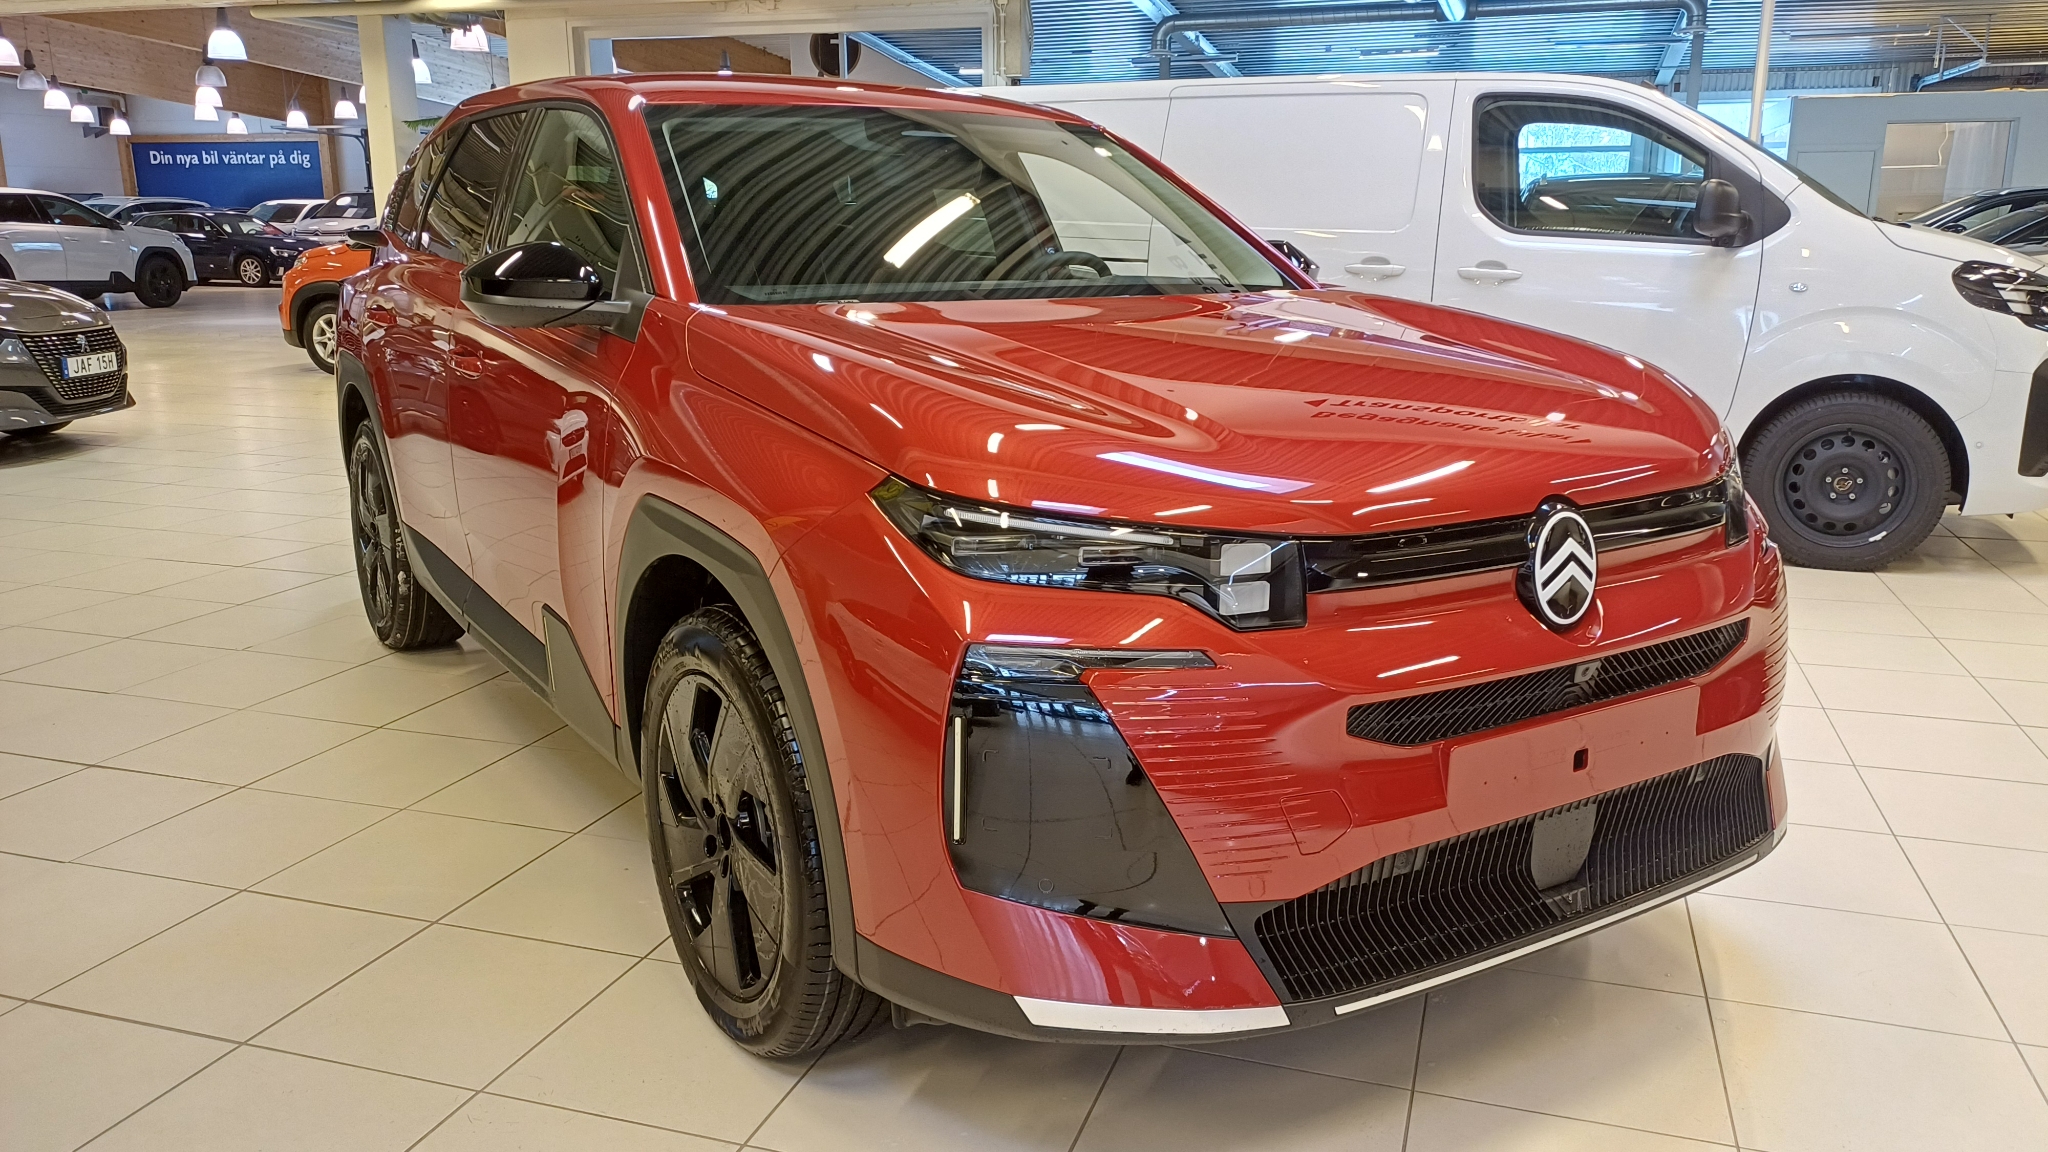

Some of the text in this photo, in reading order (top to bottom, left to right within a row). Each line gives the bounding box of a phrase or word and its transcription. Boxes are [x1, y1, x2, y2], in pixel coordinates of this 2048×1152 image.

[149, 150, 311, 168] Din nya bil väntar på dig
[73, 354, 114, 373] JAF 15H
